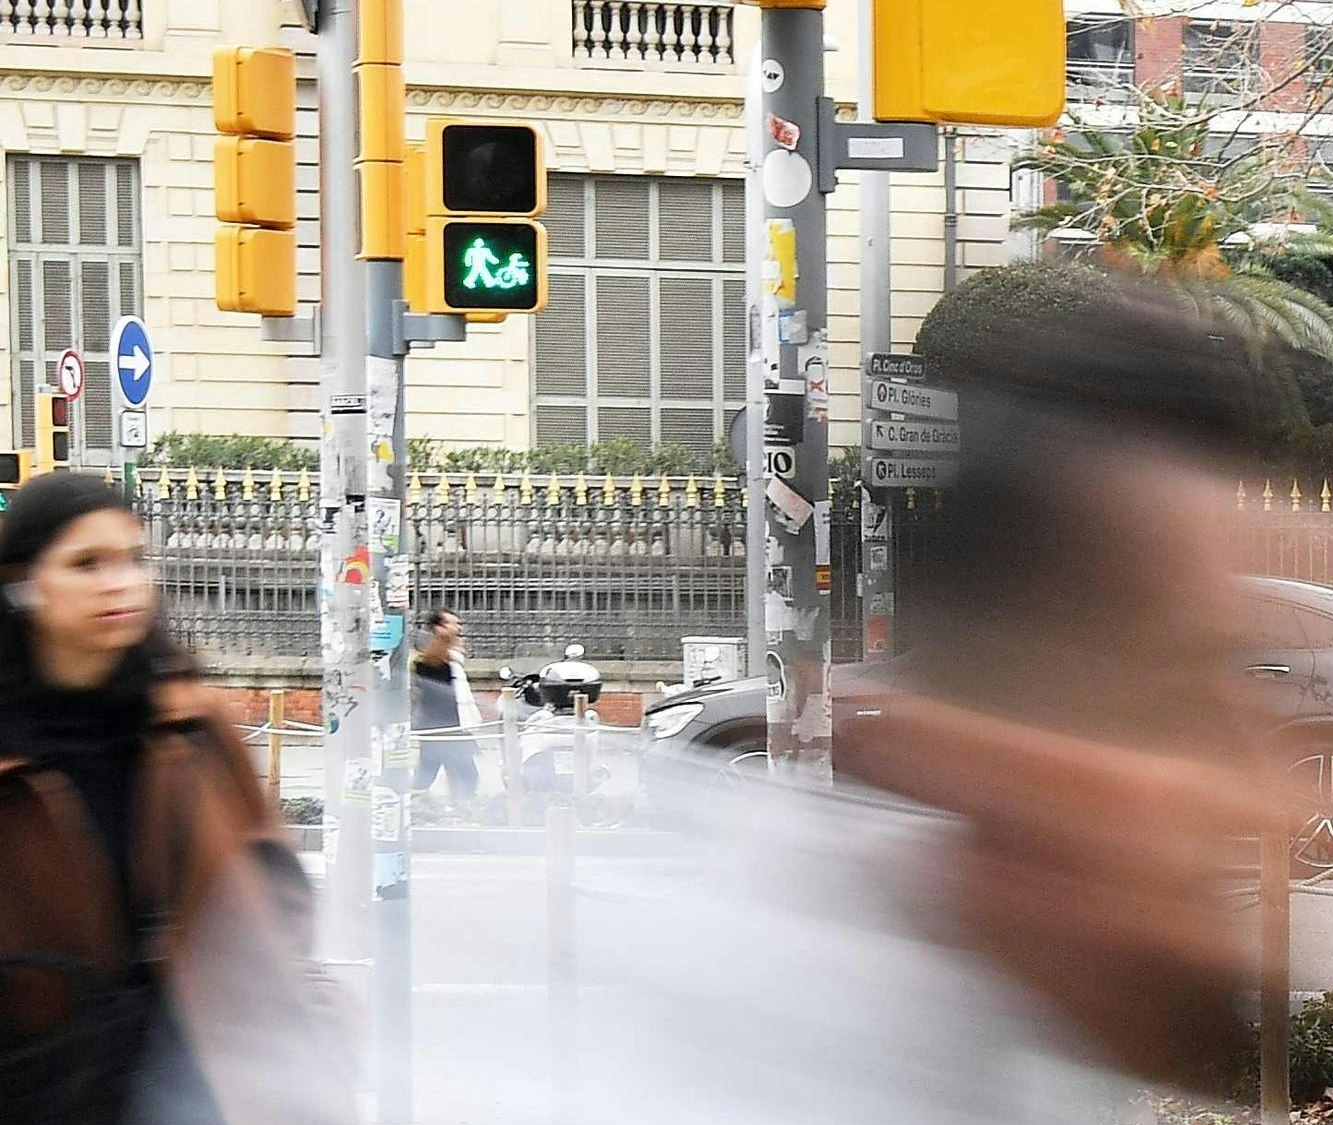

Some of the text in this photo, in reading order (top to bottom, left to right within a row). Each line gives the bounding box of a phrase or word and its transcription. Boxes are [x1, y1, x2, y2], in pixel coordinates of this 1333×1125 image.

[888, 387, 899, 402] Pl.
[888, 426, 898, 441] C.
[900, 426, 919, 442] Gran
[920, 428, 931, 443] de
[888, 462, 936, 480] Pl. Lesseps
